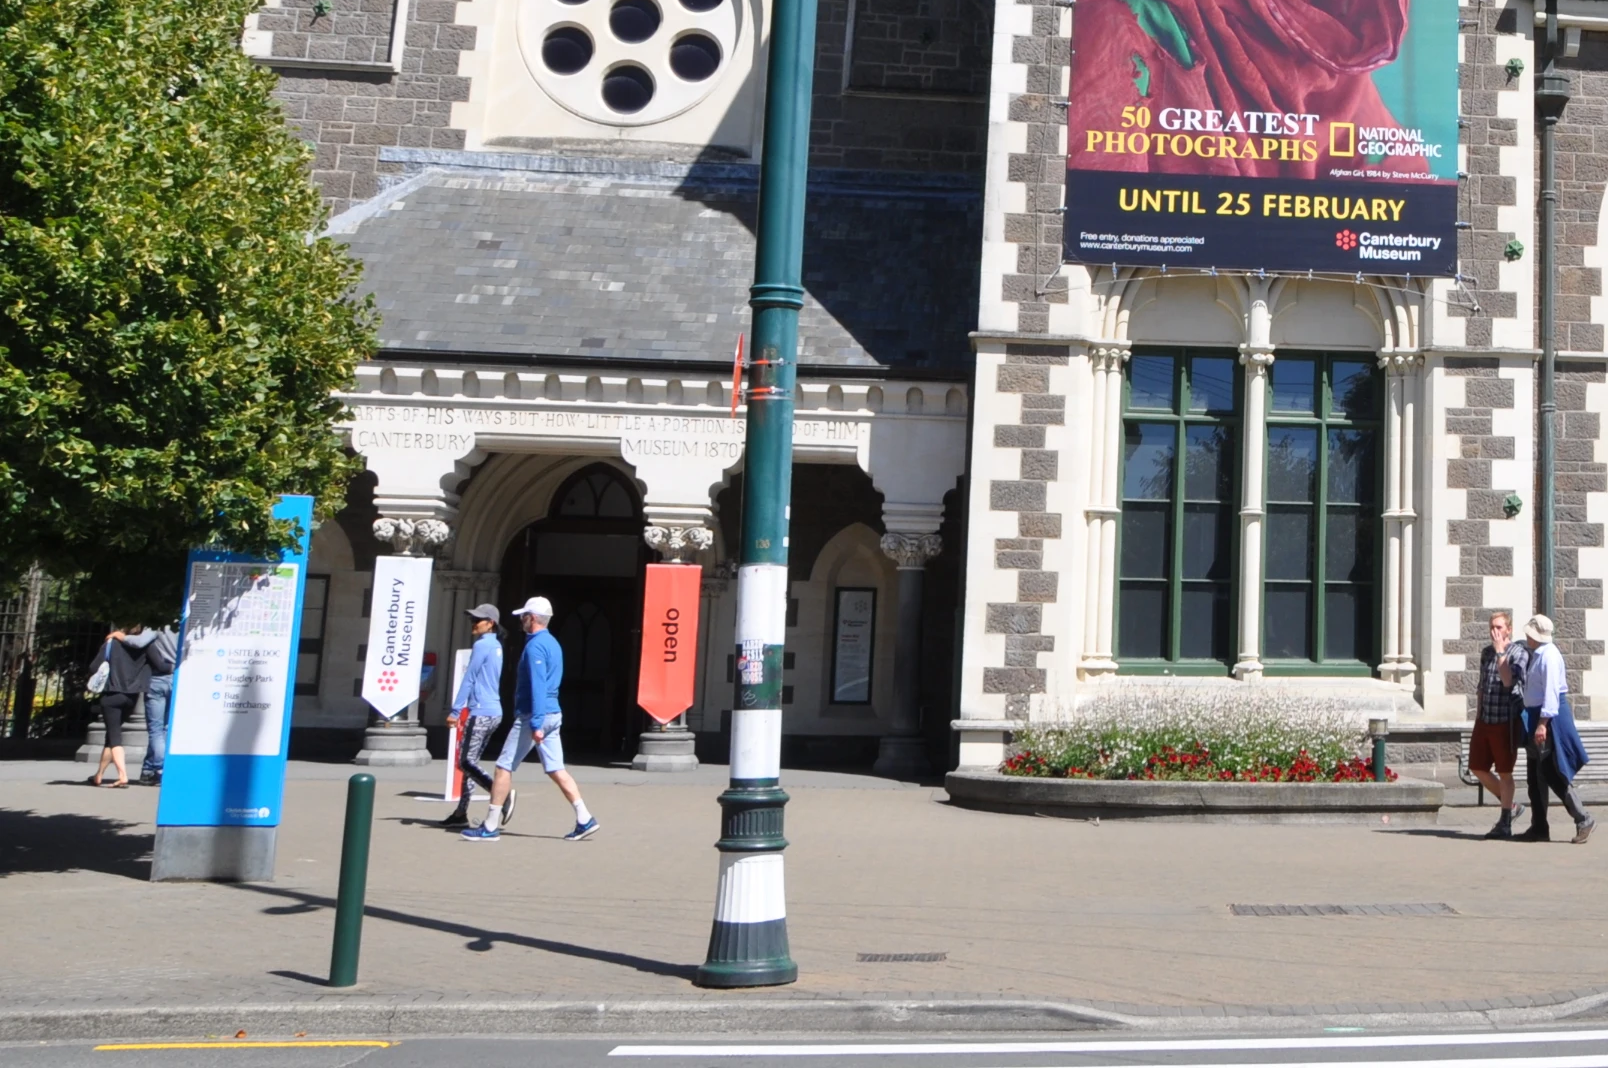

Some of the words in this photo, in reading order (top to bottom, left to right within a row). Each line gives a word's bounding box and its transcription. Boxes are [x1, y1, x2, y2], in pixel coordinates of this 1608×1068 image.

[1121, 106, 1151, 128] 50
[1158, 107, 1320, 136] GREATEST
[1358, 126, 1425, 142] NATIONAL
[1084, 130, 1319, 162] PHOTOGRAPHS
[1357, 141, 1442, 158] GEOGRAPHIC
[1329, 168, 1352, 178] Afghan
[1366, 170, 1381, 178] 1984
[1382, 170, 1391, 179] by
[1392, 171, 1410, 179] Steve
[1410, 172, 1439, 181] McCurry
[1118, 188, 1206, 215] UNTIL
[1216, 192, 1251, 216] 25
[1262, 194, 1405, 222] FEBRUARY
[1080, 231, 1098, 241] Free
[1099, 233, 1119, 243] entry,
[1121, 233, 1159, 243] donations
[1160, 236, 1205, 245] appreciated
[1080, 241, 1193, 252] www.canterburymuseum.com
[1359, 232, 1442, 250] Canterbury
[1359, 248, 1422, 261] Museum
[355, 406, 396, 422] ARTS
[402, 408, 419, 423] OF
[427, 407, 455, 425] HIS
[462, 409, 503, 426] WAYS
[510, 411, 537, 427] BUT
[546, 412, 579, 428] HOW
[587, 414, 642, 431] LITTLE
[649, 417, 656, 431] A
[663, 417, 725, 434] PORTION
[826, 421, 860, 440] HIM
[358, 431, 474, 451] CANTERBURY
[624, 439, 698, 458] MUSEUM
[704, 441, 740, 459] 1870
[381, 578, 405, 666] Canterbury
[396, 600, 416, 667] Museum
[661, 608, 680, 663] open
[225, 674, 254, 683] Hagley
[255, 674, 274, 683] Park
[224, 692, 240, 700] Bus
[223, 701, 272, 711] Interchange
